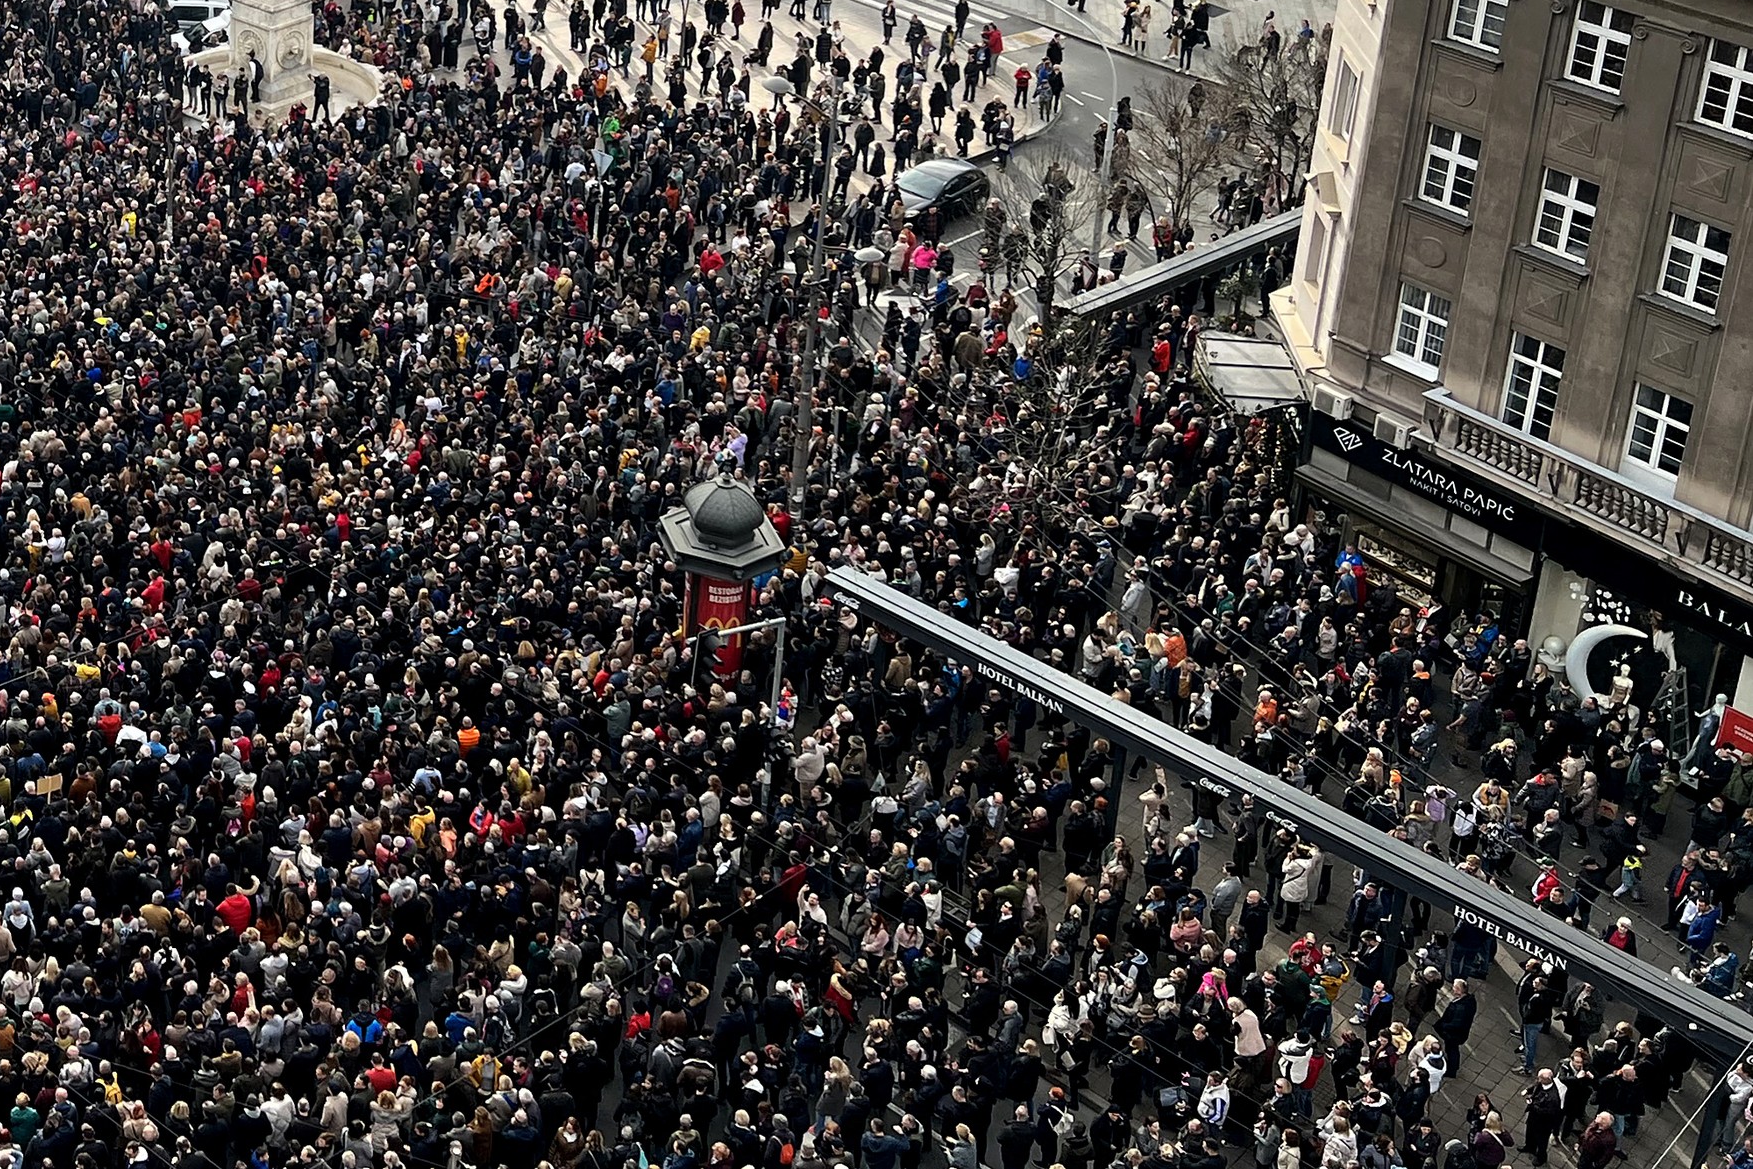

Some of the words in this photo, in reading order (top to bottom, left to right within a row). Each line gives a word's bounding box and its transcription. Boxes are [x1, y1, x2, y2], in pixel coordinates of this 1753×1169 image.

[1382, 448, 1458, 495] ZLATARA
[1464, 488, 1515, 521] PAPIĆ
[1409, 477, 1439, 496] NAKIT
[1447, 495, 1481, 517] SATOVI
[978, 662, 1016, 690] HOTEL
[1017, 683, 1064, 714] BALKAN
[1199, 777, 1232, 798] Coca-Cola
[1266, 811, 1299, 833] Coca-Cola
[1453, 905, 1503, 939] HOTEL
[1506, 931, 1568, 970] BALKAN
